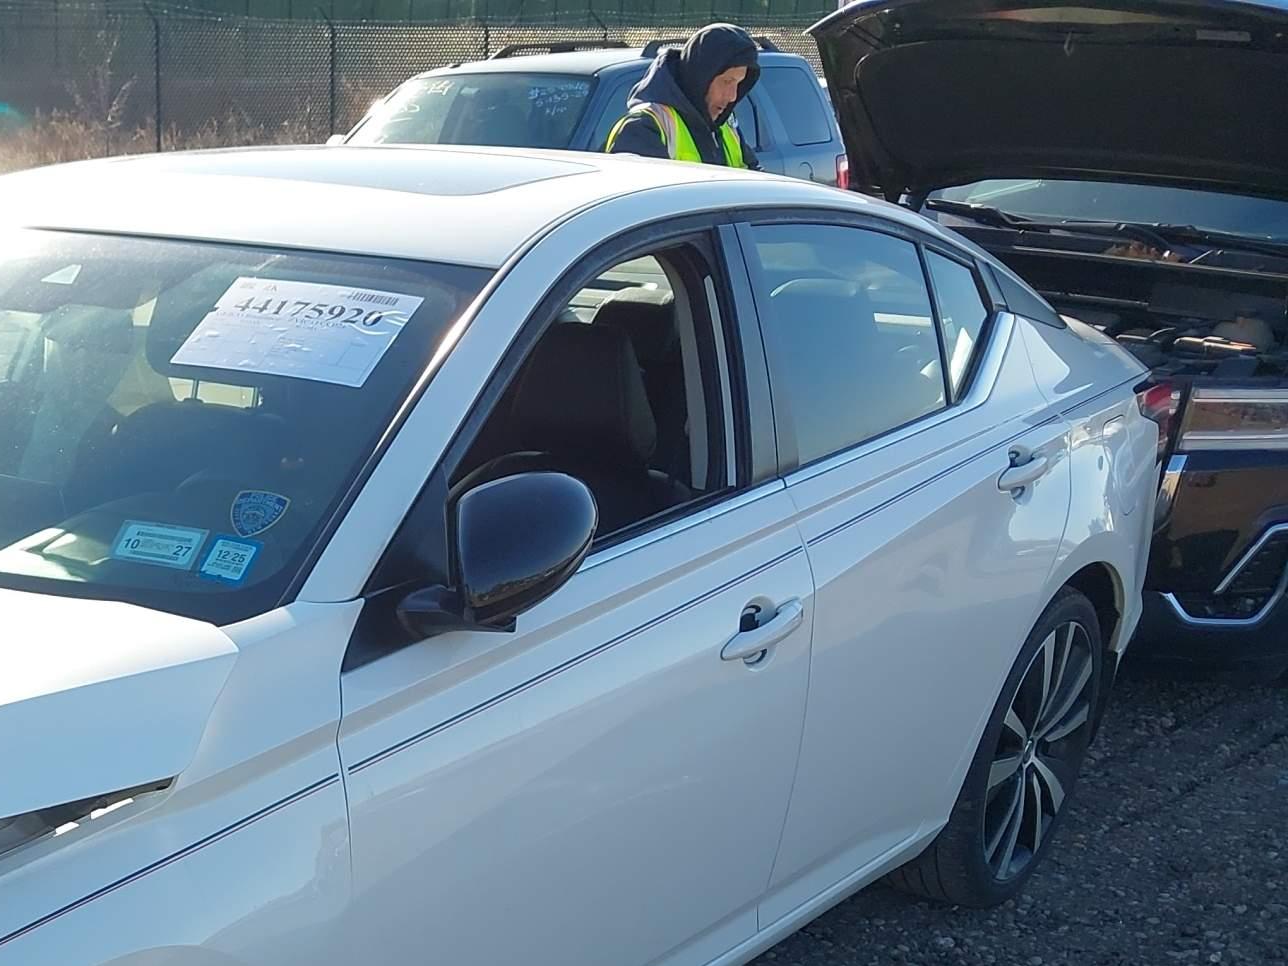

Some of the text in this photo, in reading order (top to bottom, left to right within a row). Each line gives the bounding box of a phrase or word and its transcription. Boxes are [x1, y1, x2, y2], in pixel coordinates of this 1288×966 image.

[234, 296, 383, 327] 44175920
[123, 537, 141, 549] 10
[172, 545, 193, 557] 27
